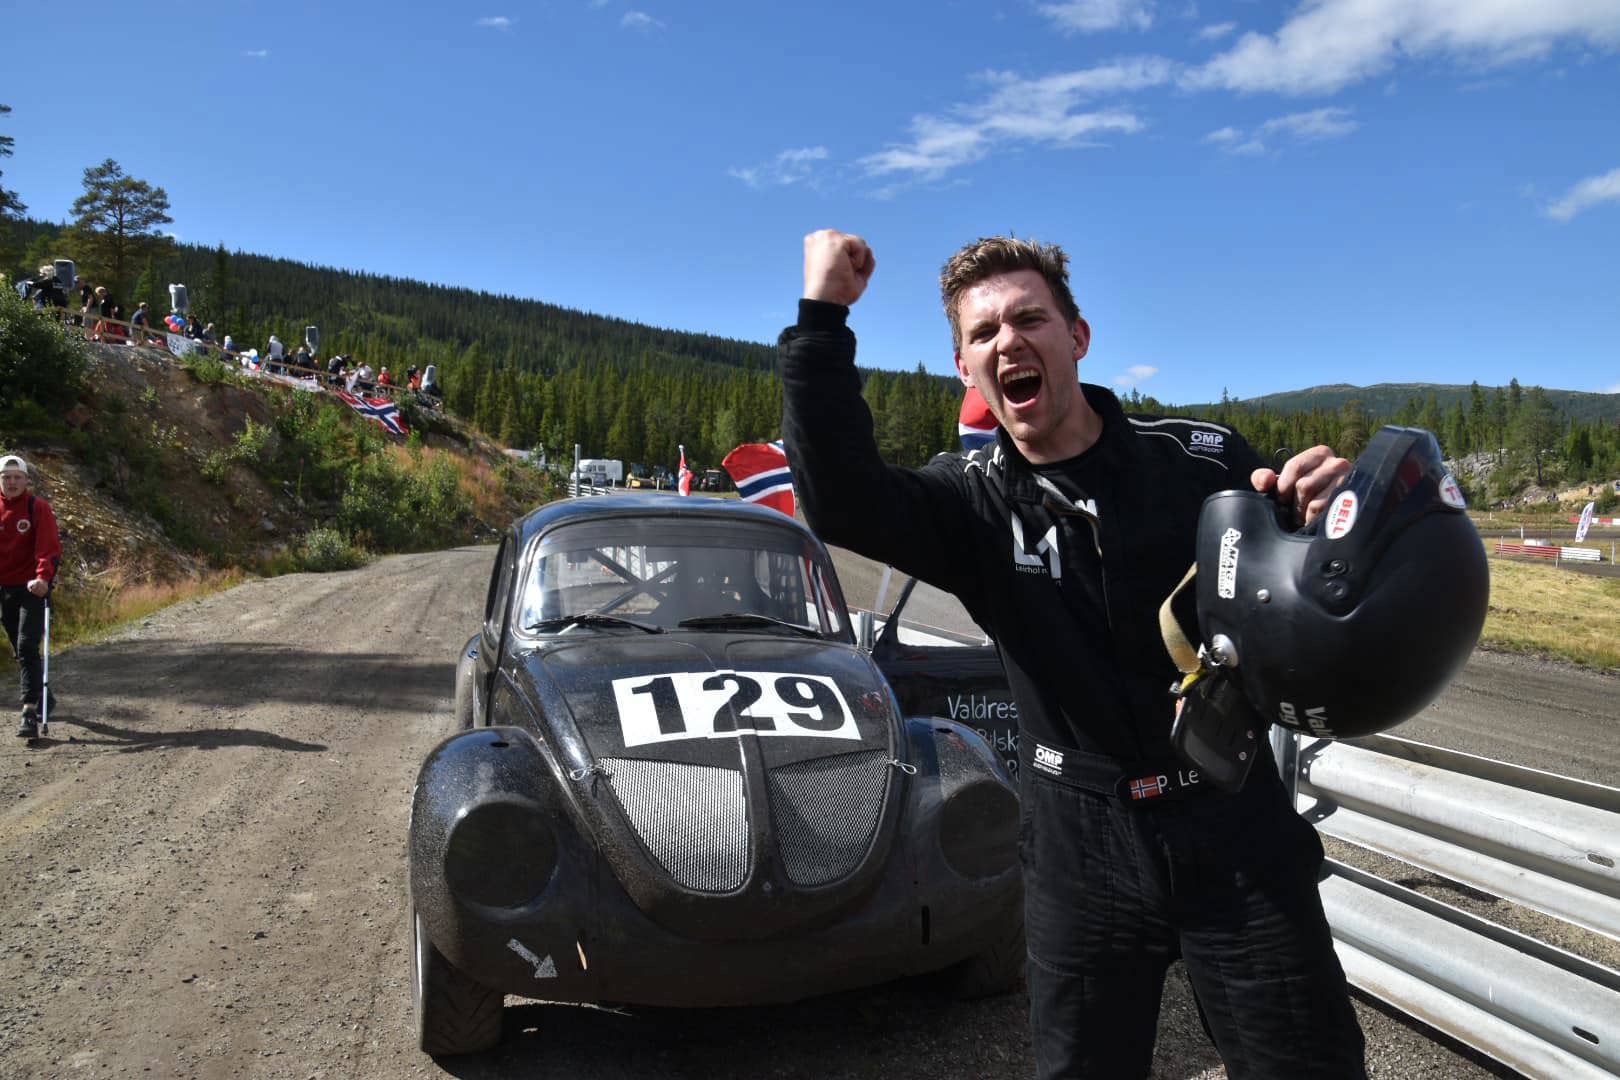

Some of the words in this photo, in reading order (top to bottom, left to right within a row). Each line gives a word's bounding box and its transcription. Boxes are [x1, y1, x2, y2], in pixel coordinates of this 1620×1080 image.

[1191, 432, 1224, 446] OMP
[1333, 499, 1353, 534] BELL
[631, 673, 845, 735] 129
[948, 694, 1019, 719] Valdres
[1035, 747, 1063, 767] OMP
